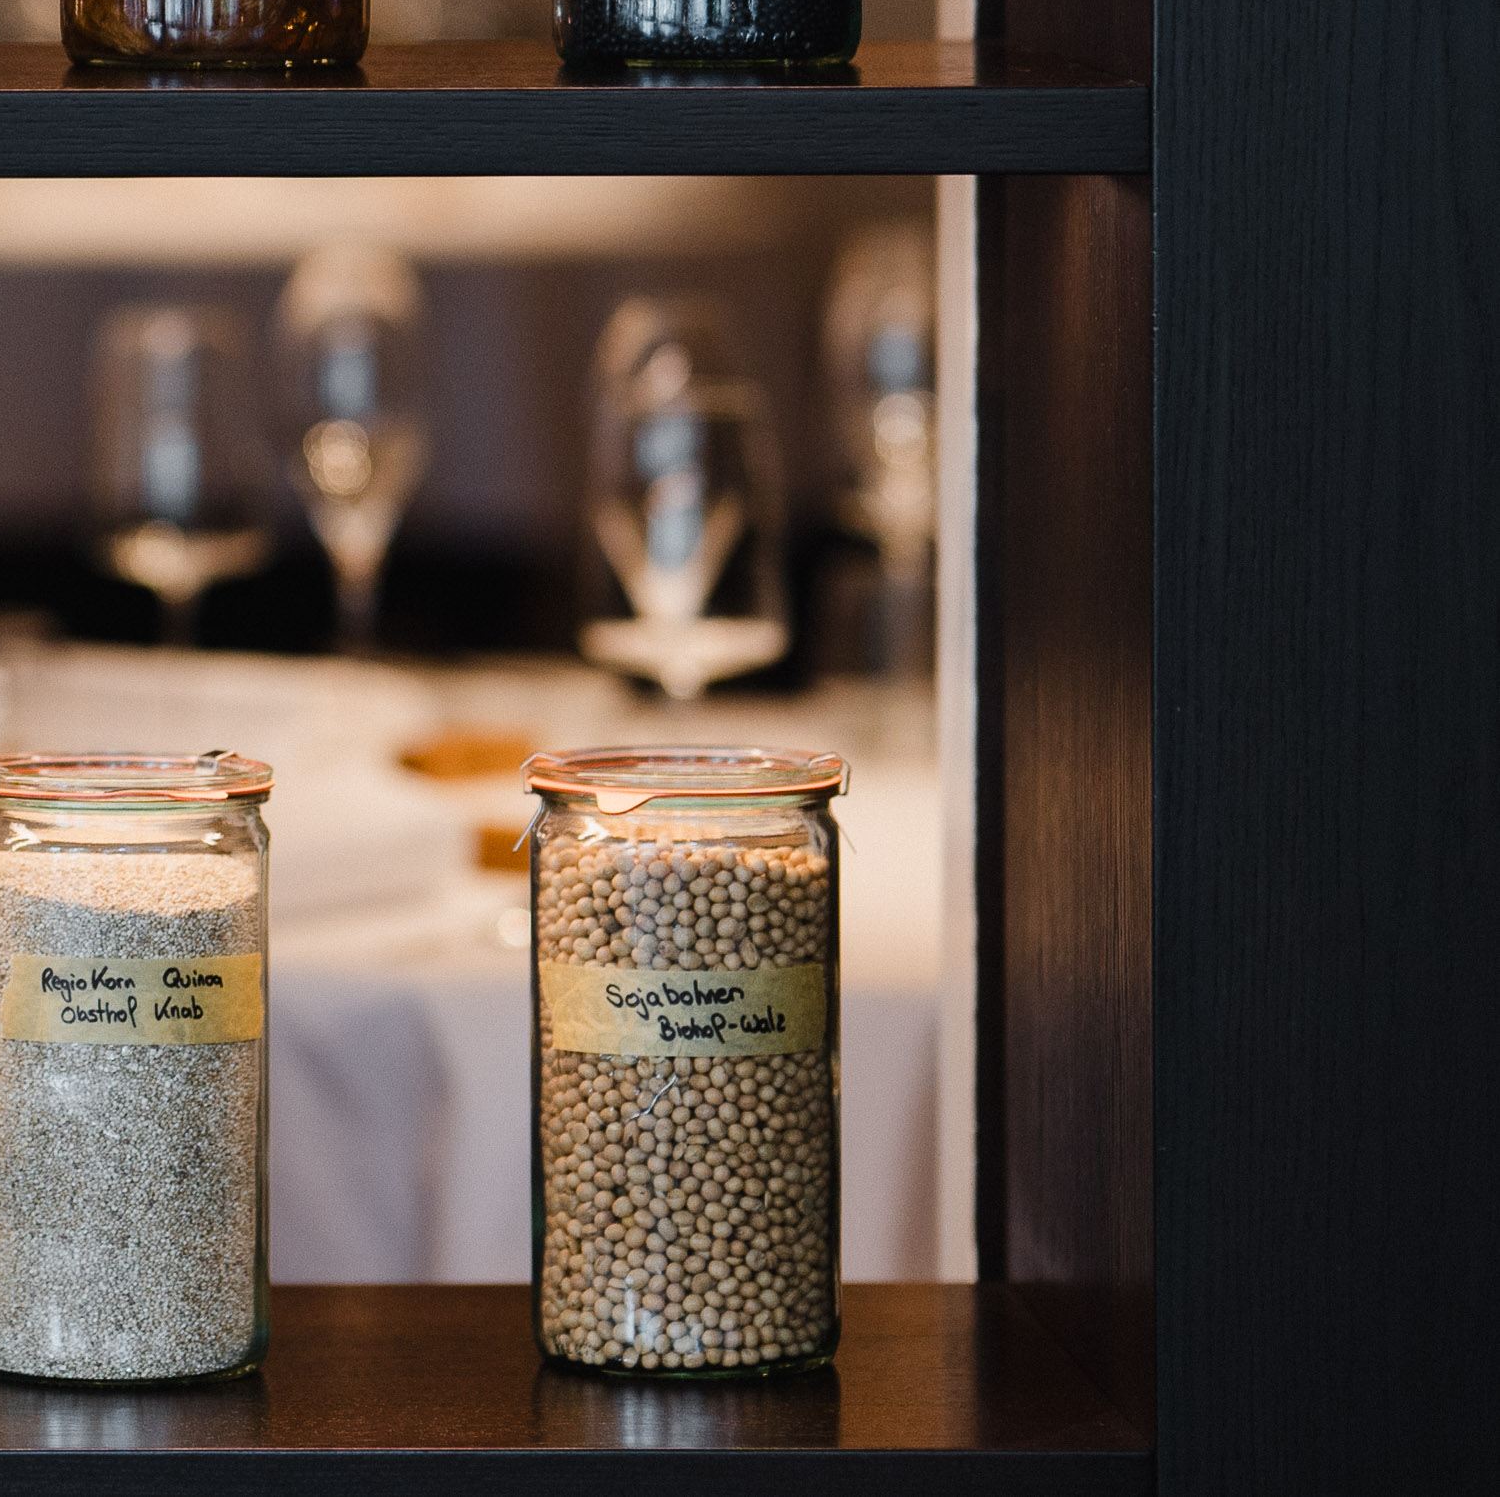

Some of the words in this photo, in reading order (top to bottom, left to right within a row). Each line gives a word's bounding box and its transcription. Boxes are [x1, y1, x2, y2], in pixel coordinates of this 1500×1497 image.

[162, 967, 224, 988] Quinoa
[60, 996, 137, 1028] Obsthof
[154, 995, 204, 1022] Knab
[605, 980, 745, 1020] Sojabohnen
